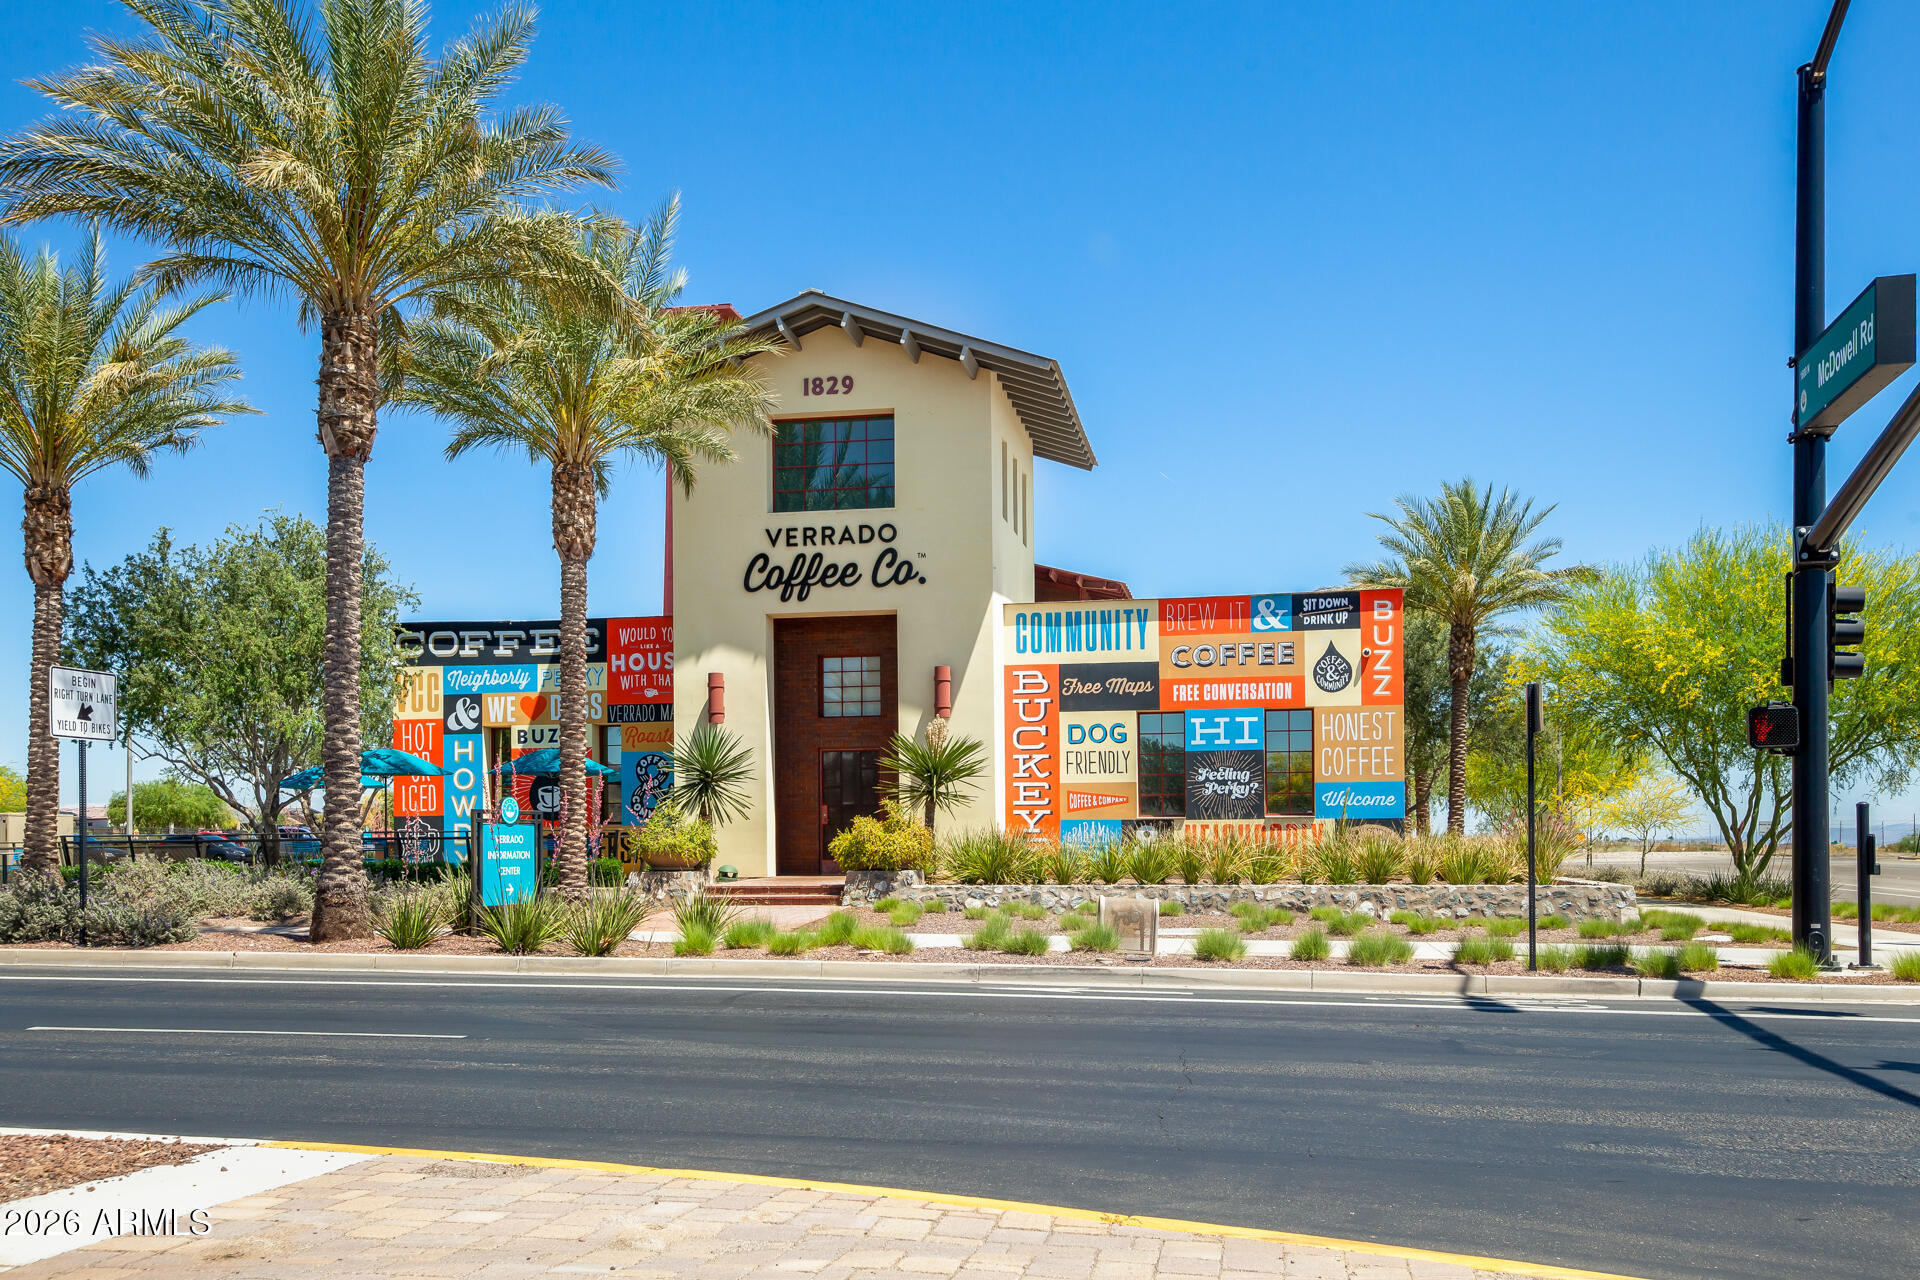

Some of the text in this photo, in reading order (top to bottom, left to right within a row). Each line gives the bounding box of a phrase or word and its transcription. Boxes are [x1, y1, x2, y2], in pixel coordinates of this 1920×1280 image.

[1818, 313, 1874, 389] McDowell Rd
[803, 375, 854, 396] 1829
[765, 523, 898, 548] VERRADO
[743, 547, 927, 603] Coffee Co.
[1253, 599, 1289, 630] &
[1303, 597, 1349, 612] SIT DOWN
[1166, 601, 1245, 632] BREW IT
[1303, 611, 1349, 625] DRINK UP
[619, 626, 674, 647] WOULD YO
[1015, 608, 1149, 654] COMMUNITY
[1170, 641, 1295, 668] COFFEE
[1373, 600, 1394, 696] BUZZ
[611, 651, 674, 673] HOUS
[1316, 655, 1348, 675] COFFEE
[1326, 664, 1340, 681] &
[72, 676, 96, 688] BEGIN
[447, 670, 531, 692] Neighborly
[620, 673, 674, 690] WITH THA
[1062, 677, 1154, 696] Free Maps
[1316, 672, 1350, 690] COMMUNITY
[54, 688, 113, 705] RIGHT TURN LANE
[1173, 682, 1292, 702] FREE CONVERSATION
[447, 697, 480, 731] &
[487, 696, 516, 722] WE
[609, 703, 674, 722] VERRADO MA
[57, 720, 111, 735] YIELD TO BIKES
[402, 723, 436, 751] HOT
[517, 728, 560, 744] BUZ
[624, 726, 674, 749] Roaste
[1067, 723, 1128, 744] DOG
[1190, 716, 1259, 745] HI
[1321, 712, 1396, 742] HONEST
[1012, 670, 1053, 843] BUCKEY
[1066, 750, 1131, 775] FRIENDLY
[1321, 746, 1396, 776] COFFEE
[1195, 766, 1251, 783] Feeling
[402, 784, 437, 812] ICED
[1202, 781, 1259, 799] Perky?
[1321, 791, 1397, 806] Welcome
[1069, 793, 1127, 809] COFFEE & COMPANY
[495, 835, 524, 844] VERRADO
[487, 851, 530, 859] INFORMATION
[500, 867, 520, 875] CENTER
